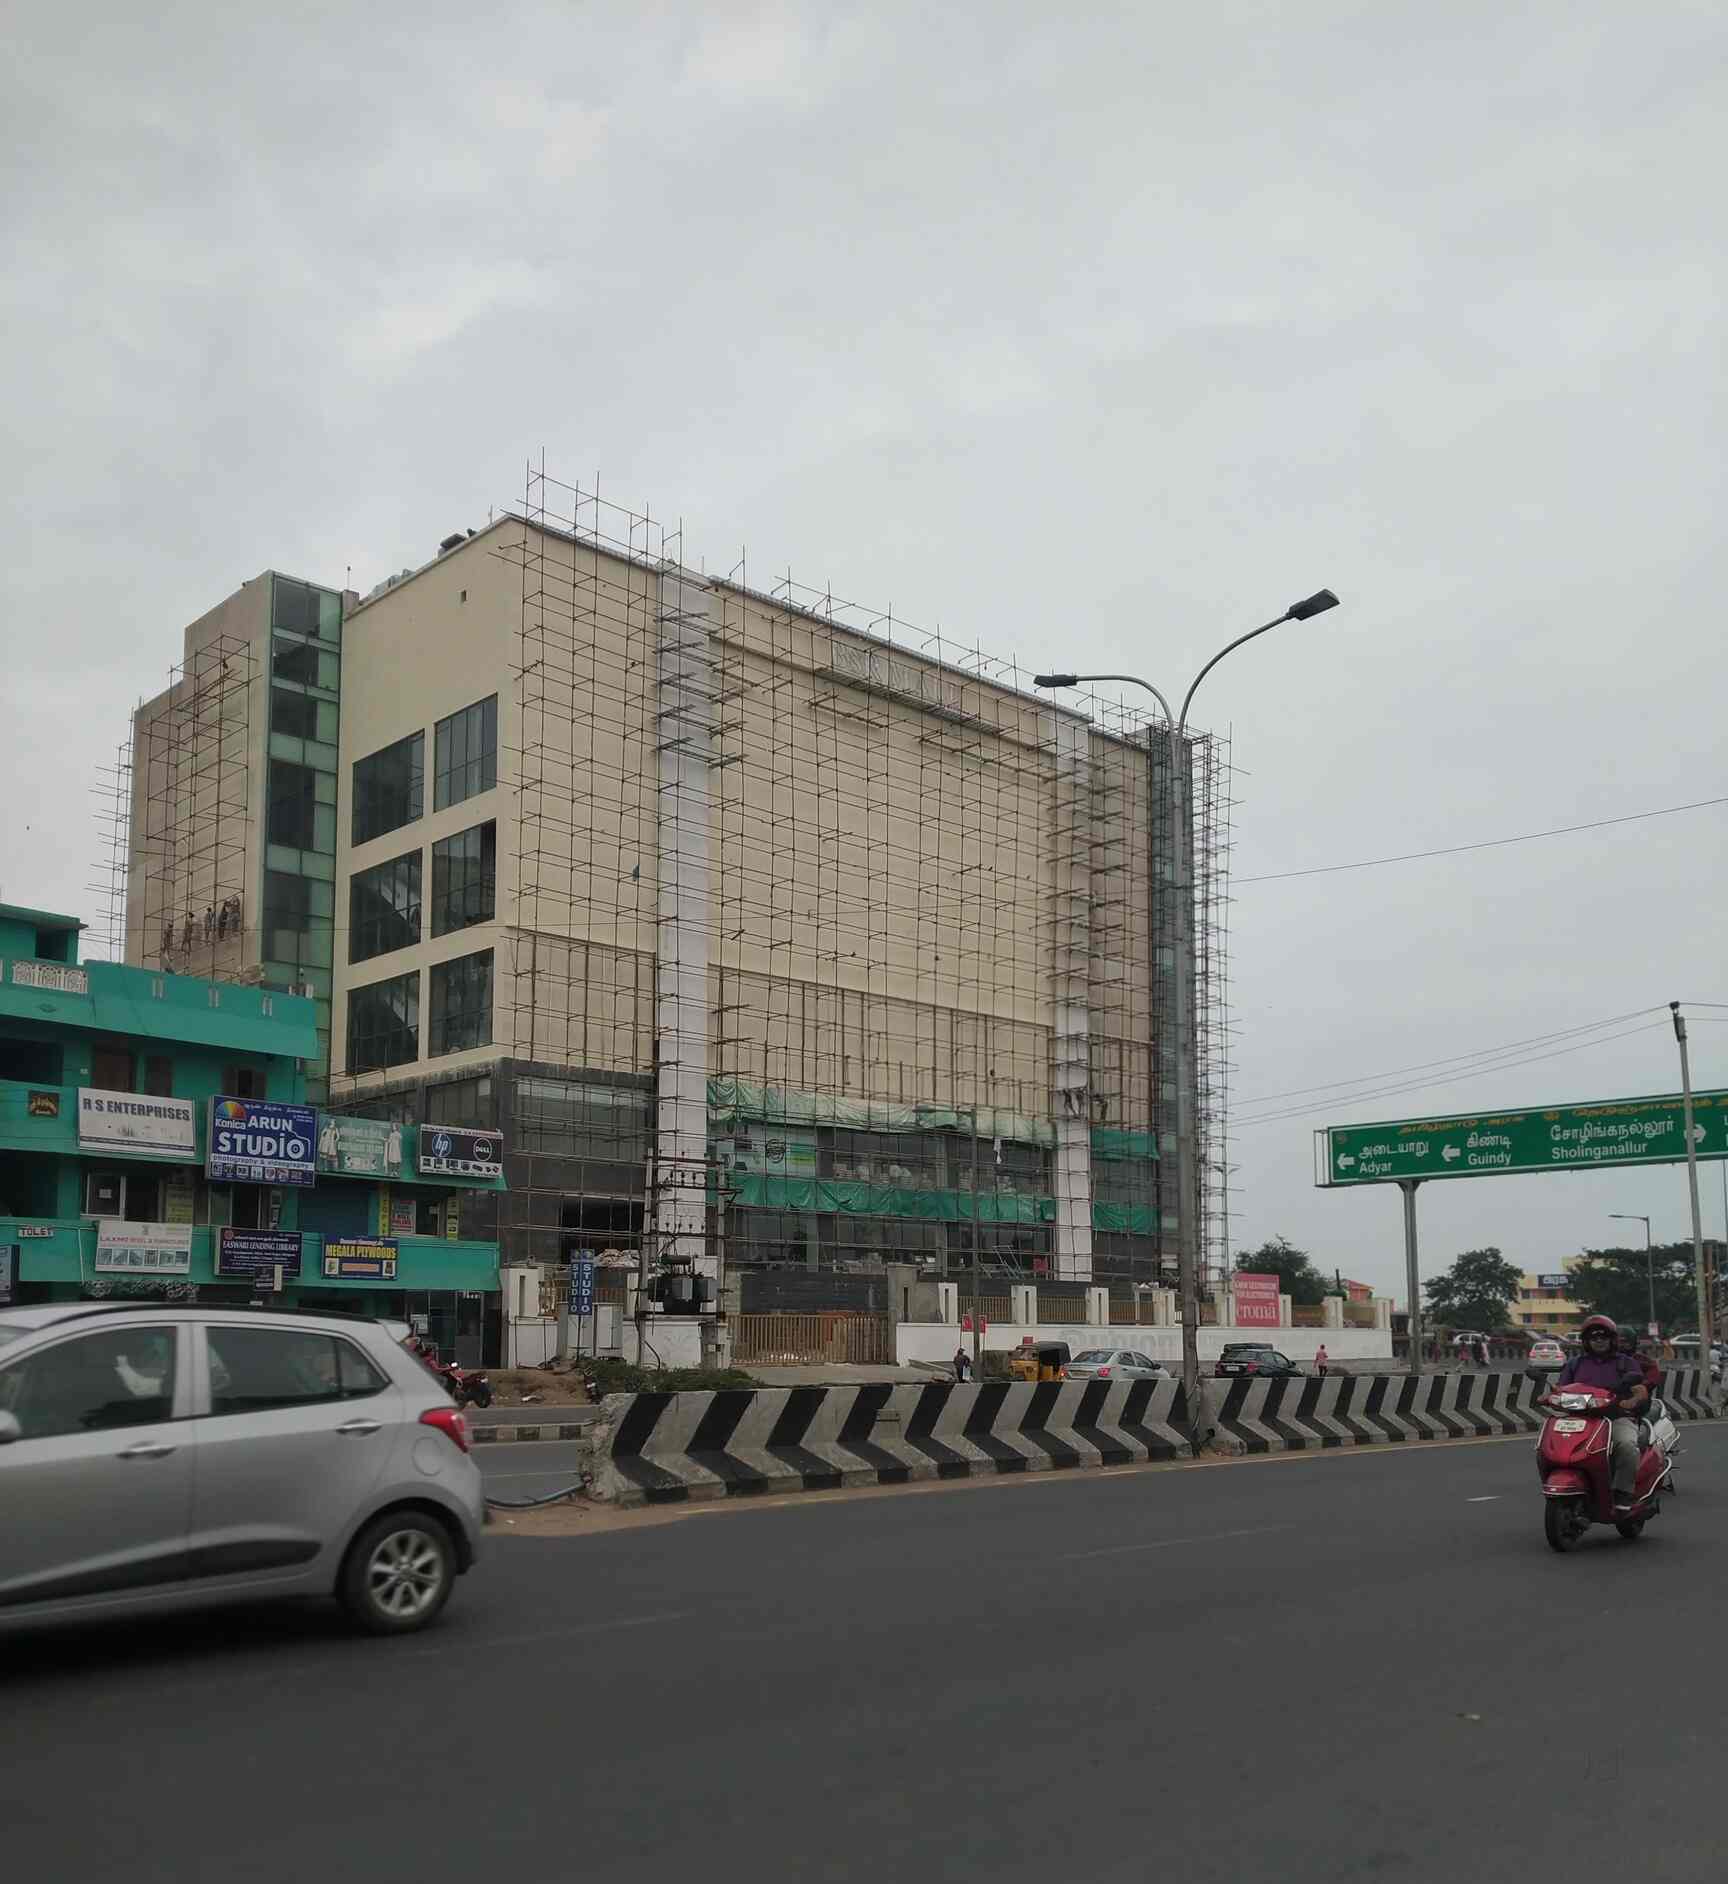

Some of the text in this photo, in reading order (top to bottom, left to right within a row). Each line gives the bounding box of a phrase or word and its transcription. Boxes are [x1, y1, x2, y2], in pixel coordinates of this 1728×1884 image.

[83, 1098, 191, 1121] R S ENTERPRISES
[215, 1118, 246, 1130] Konica
[247, 1115, 293, 1132] ARUN
[1550, 1115, 1675, 1143] சோழிங்கநல்லூர்
[1467, 1132, 1511, 1149] கிண்டி
[475, 1145, 490, 1154] DELL
[1358, 1141, 1429, 1160] அடையாறு
[1551, 1142, 1648, 1160] Sholinganallur
[1468, 1152, 1511, 1166] Guindy
[1359, 1161, 1392, 1175] Adyar
[275, 1243, 298, 1251] LIBRARY
[325, 1244, 396, 1259] MEGALA PLYWOODS
[570, 1264, 579, 1312] STUDIO
[581, 1264, 593, 1312] STUDIO
